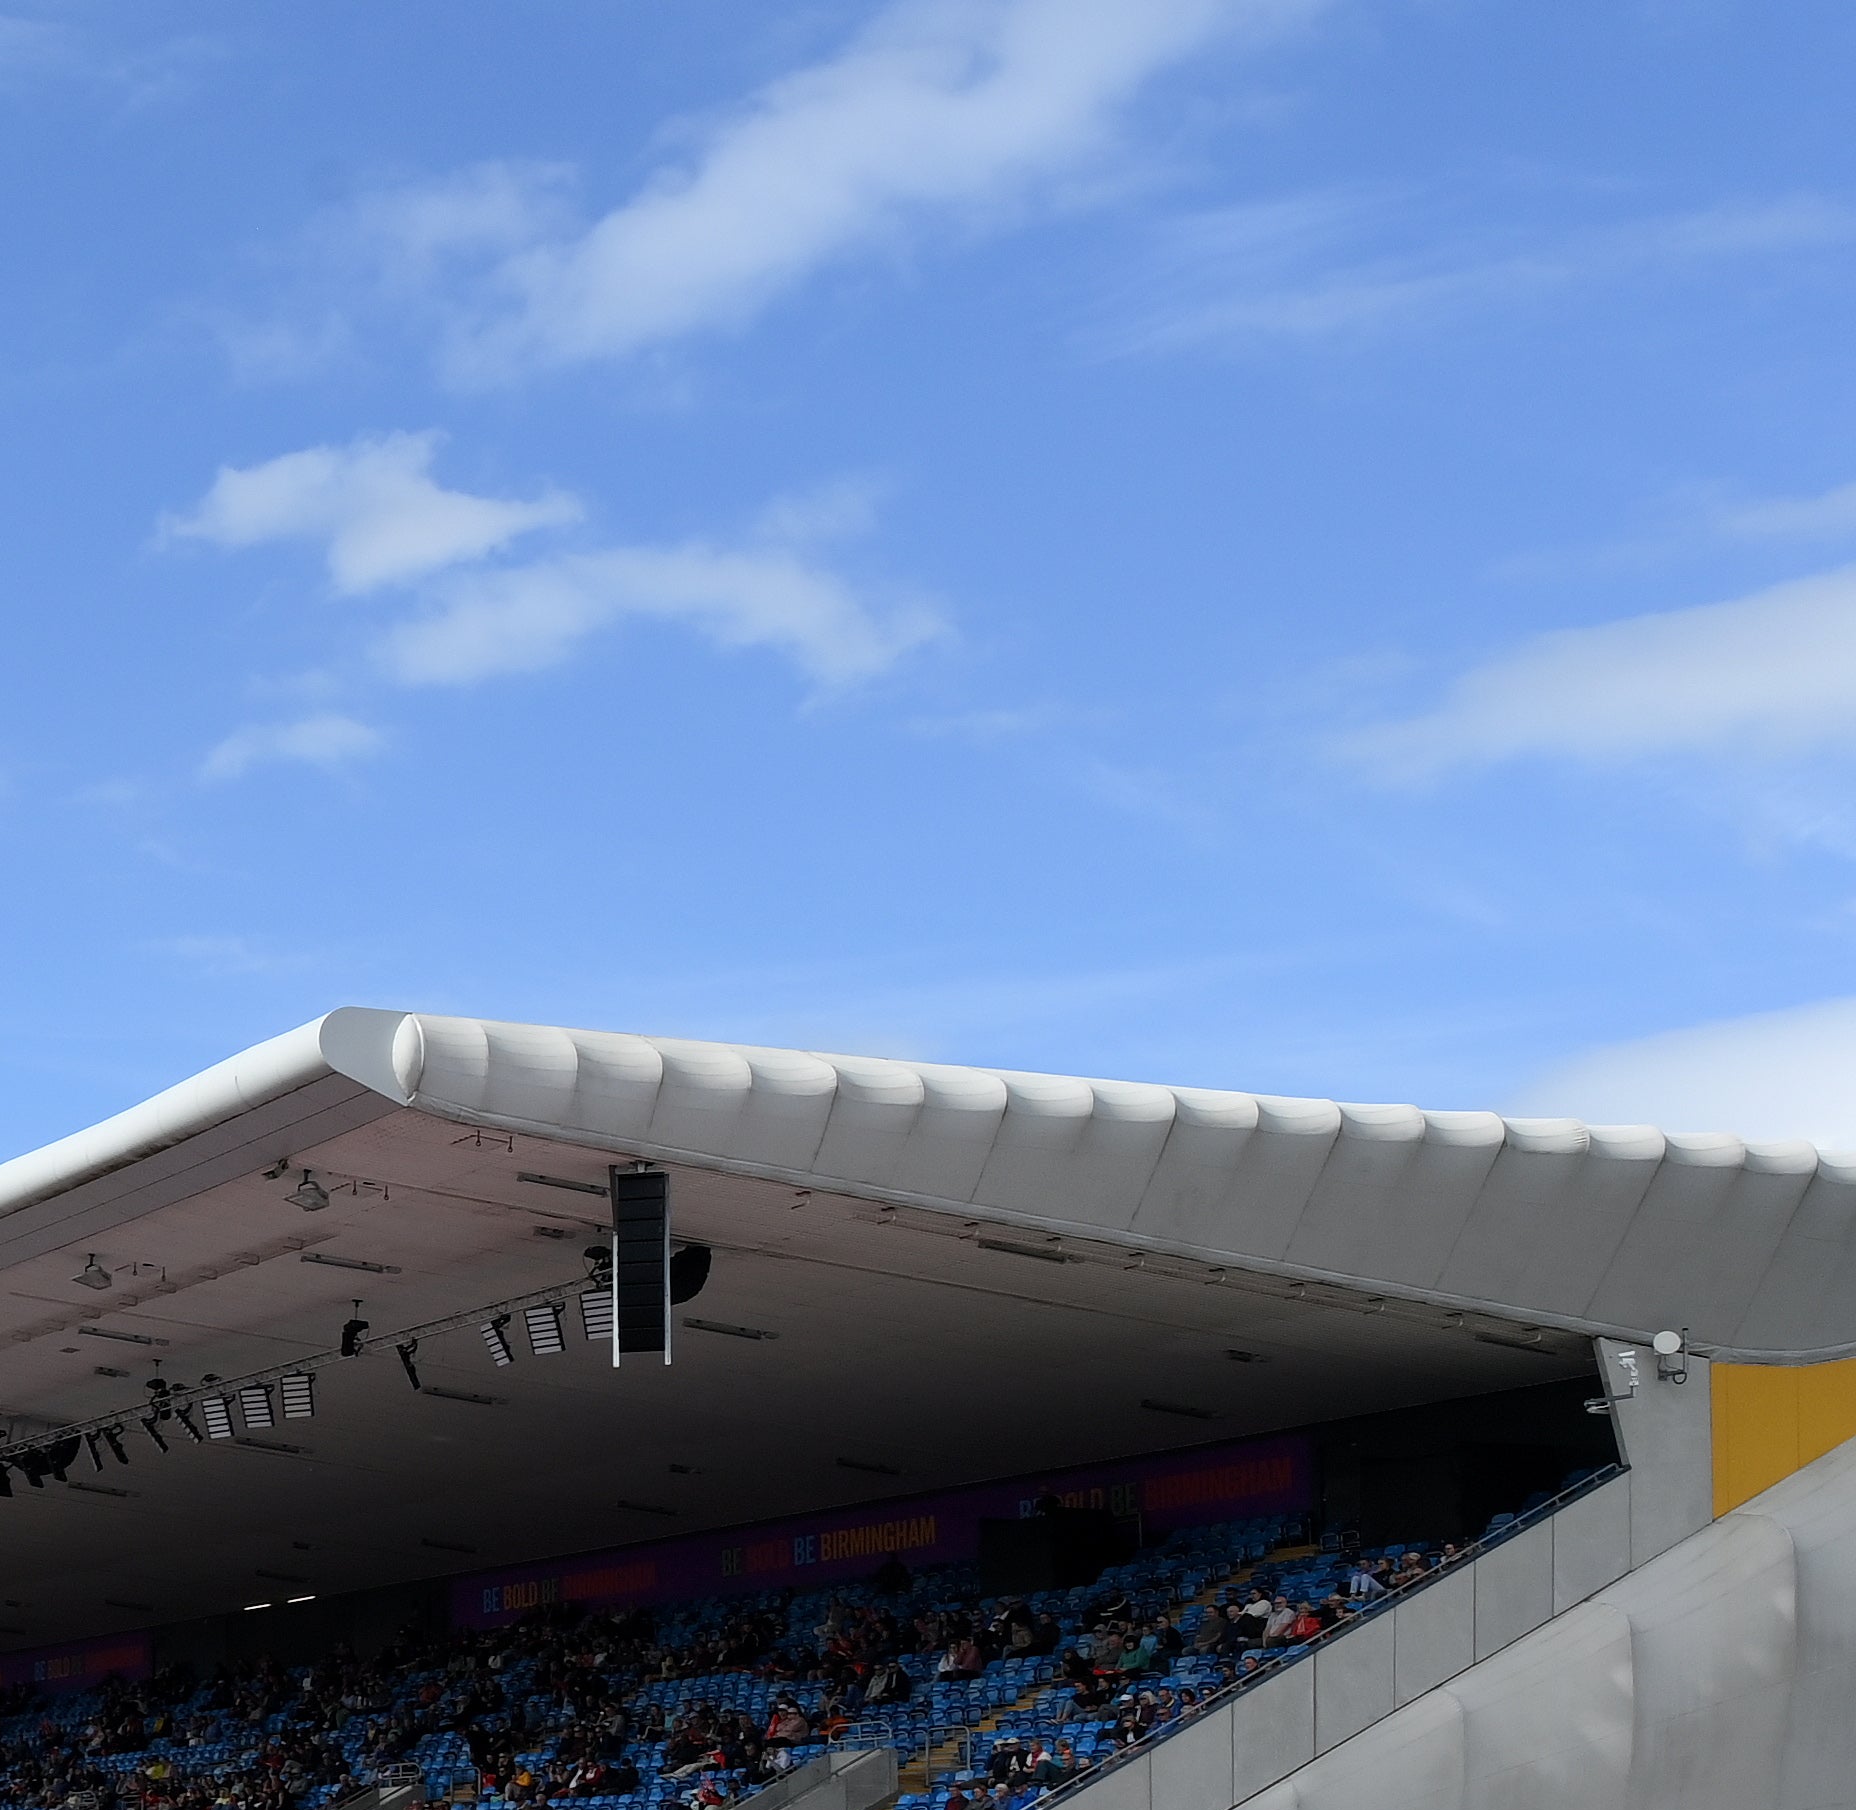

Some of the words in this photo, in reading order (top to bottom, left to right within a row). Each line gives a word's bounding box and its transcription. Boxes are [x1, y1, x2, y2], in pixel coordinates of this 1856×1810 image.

[793, 1536, 816, 1567] BE
[820, 1515, 937, 1561] BIRMINGHAM
[482, 1586, 501, 1614] BE
[502, 1582, 538, 1611] BOLD
